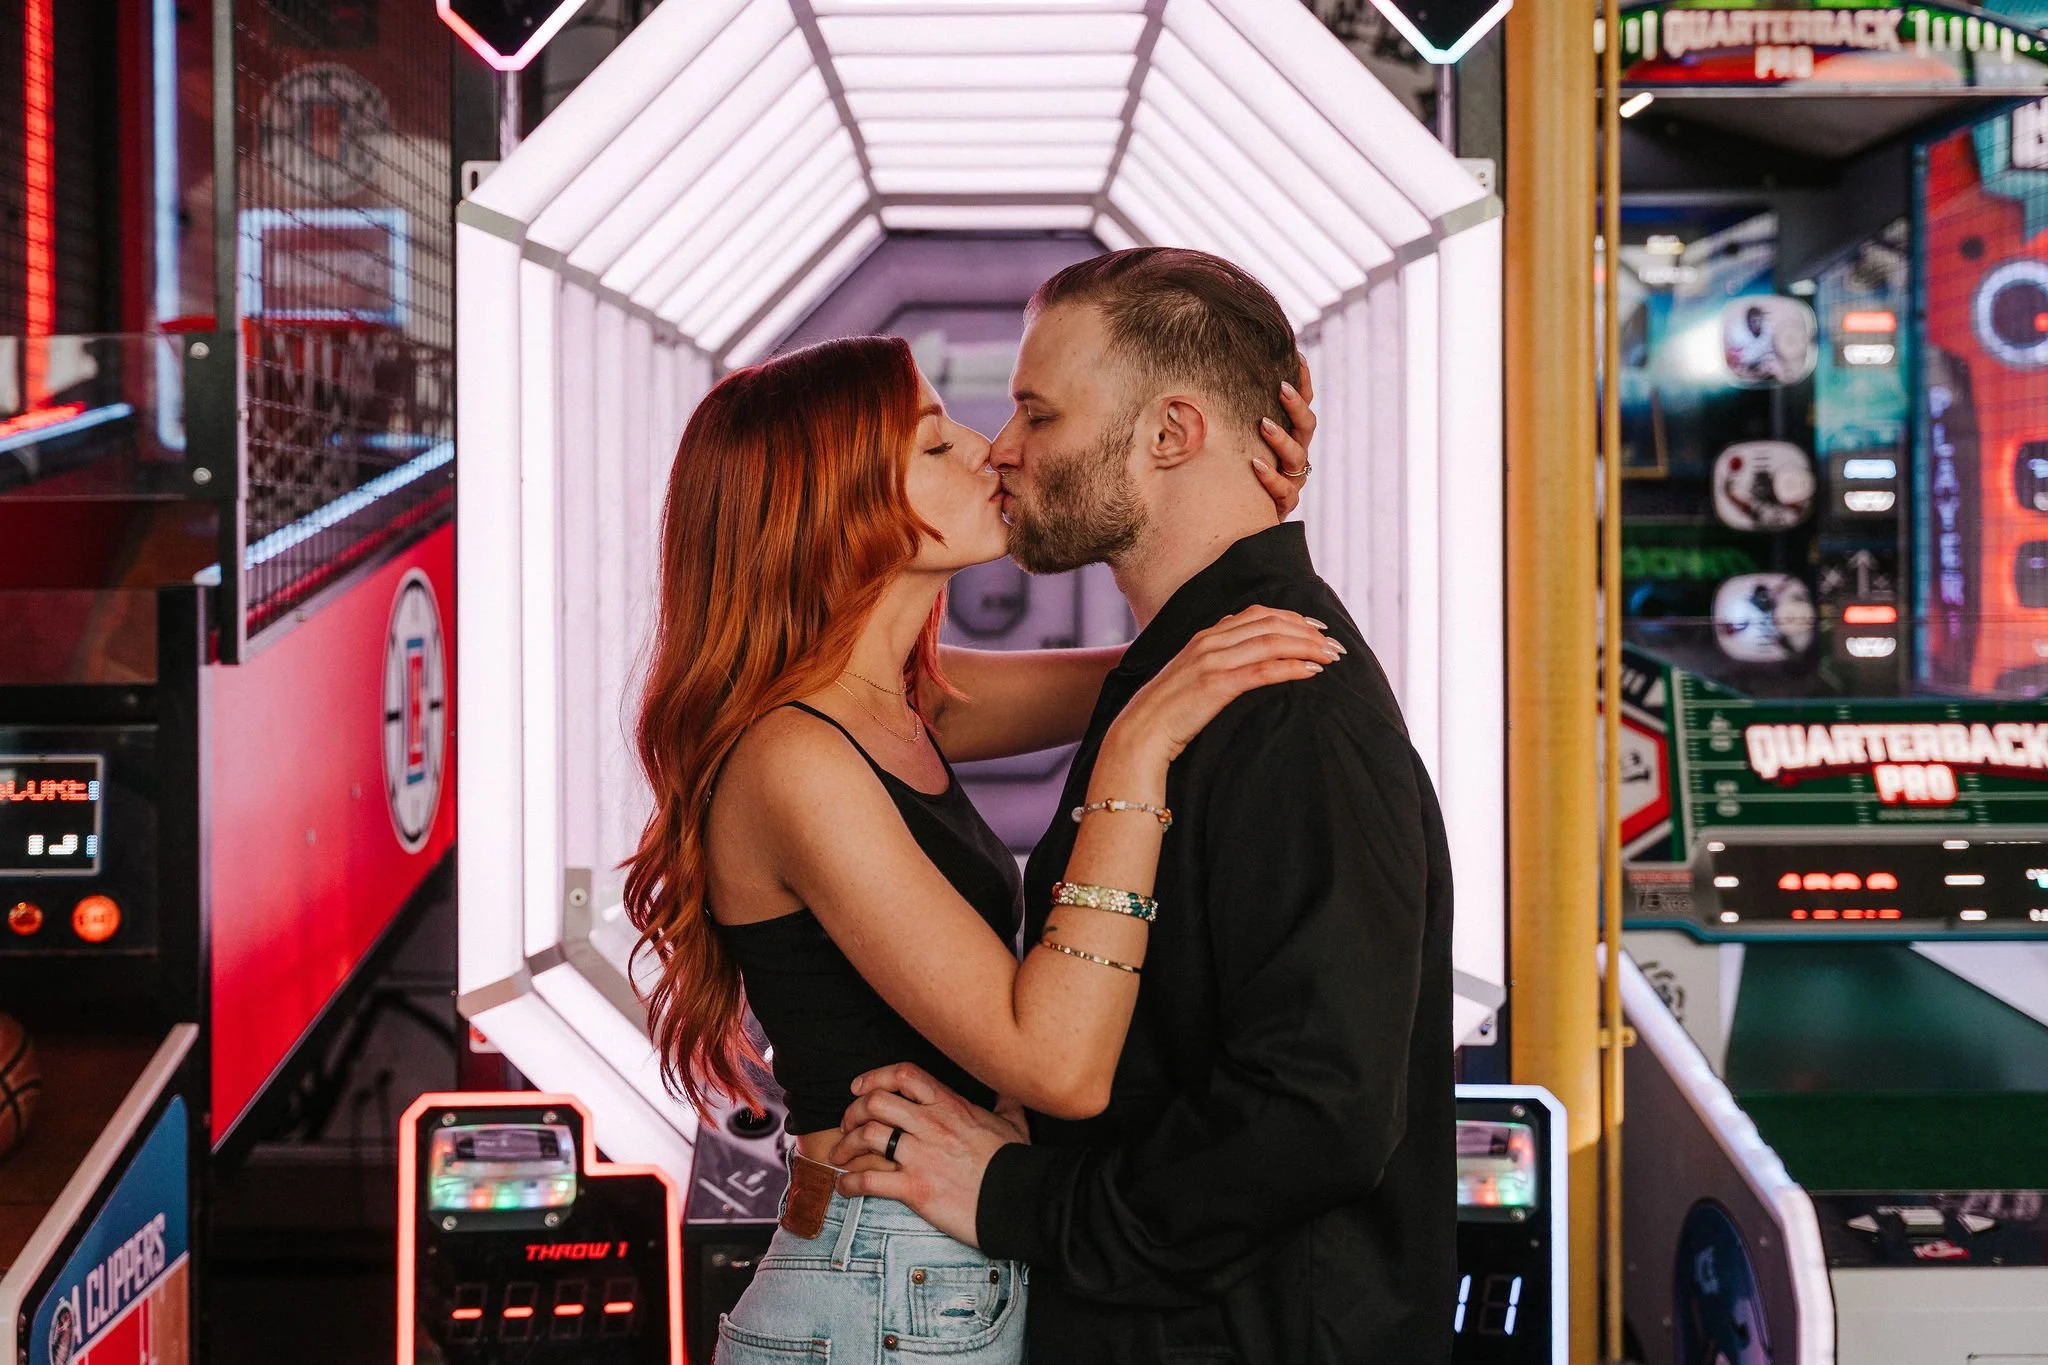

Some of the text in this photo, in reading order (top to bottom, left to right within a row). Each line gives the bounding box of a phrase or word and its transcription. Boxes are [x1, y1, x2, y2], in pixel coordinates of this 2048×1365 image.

[1875, 764, 1957, 803] PRO
[525, 1241, 628, 1261] THROW 1
[86, 1212, 166, 1335] CLIPPERS
